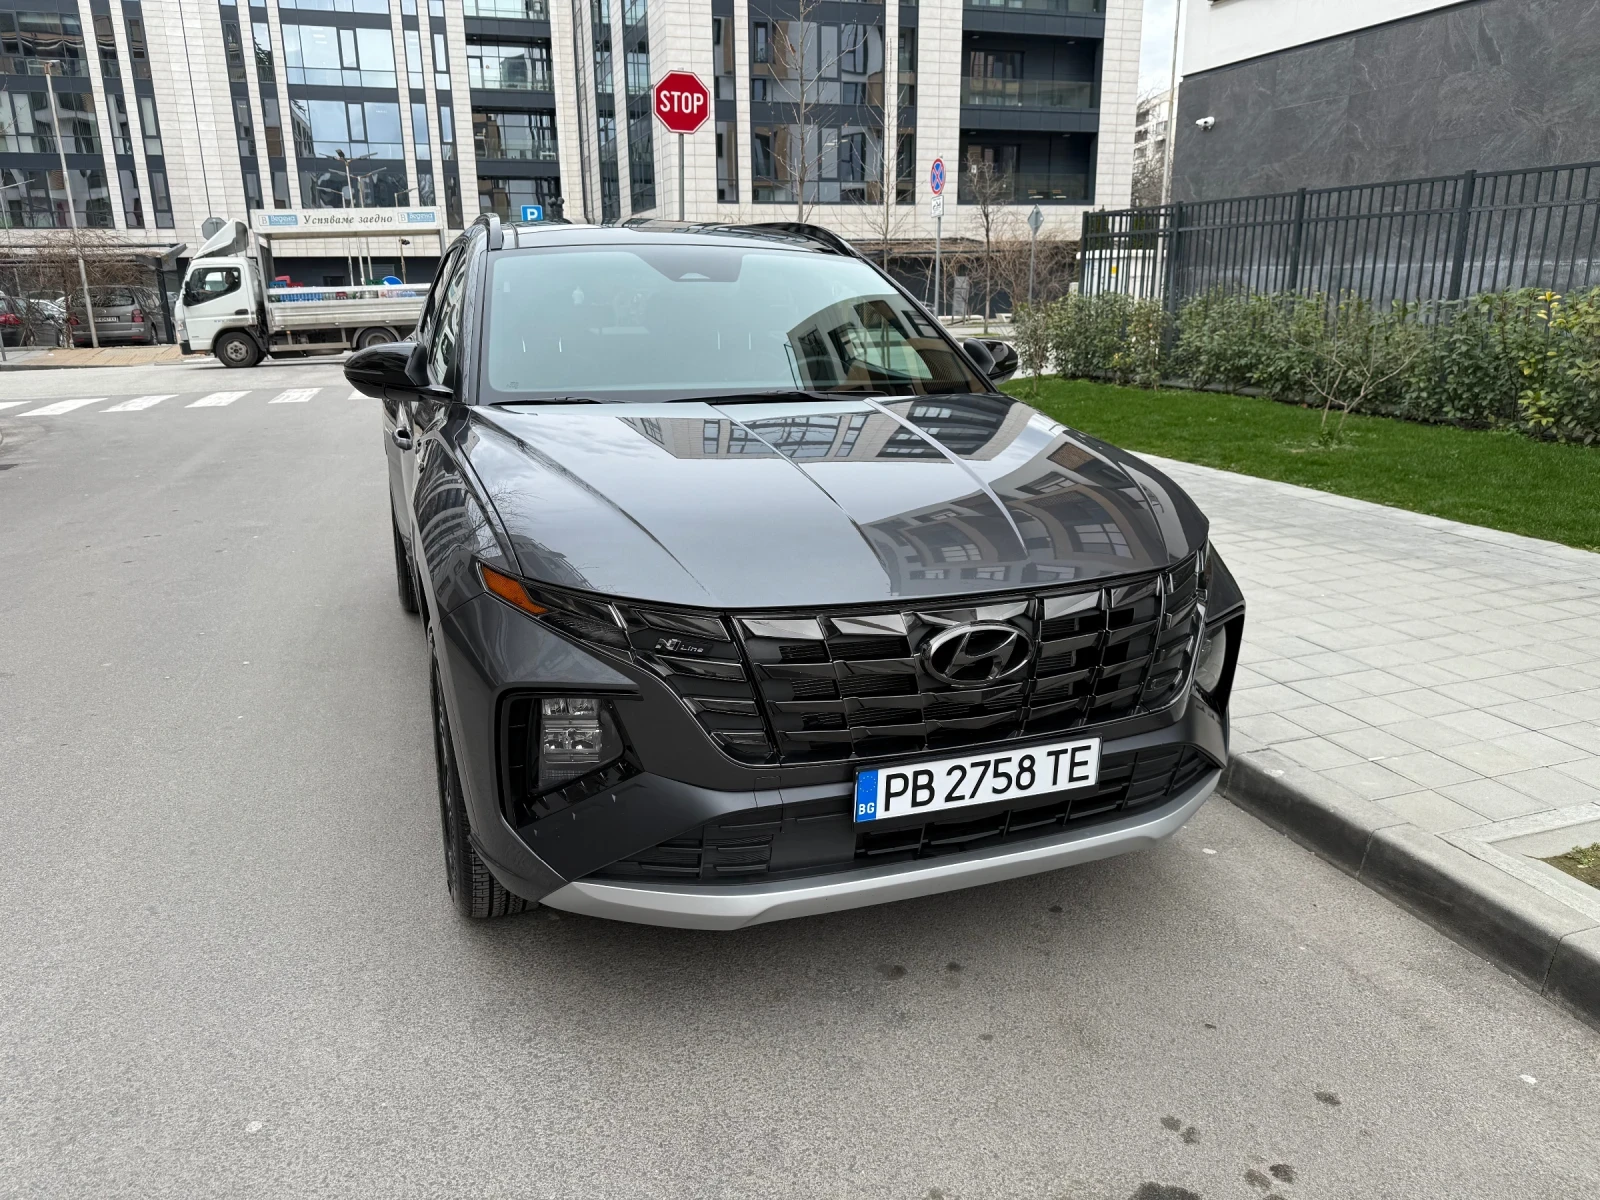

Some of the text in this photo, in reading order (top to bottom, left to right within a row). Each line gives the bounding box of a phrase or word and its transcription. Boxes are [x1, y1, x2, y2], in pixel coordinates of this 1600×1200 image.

[660, 90, 704, 114] STOP
[303, 213, 393, 225] Успяваме заедно
[527, 208, 538, 220] P
[884, 745, 1092, 812] PB 2758 TE
[858, 802, 875, 815] BG
